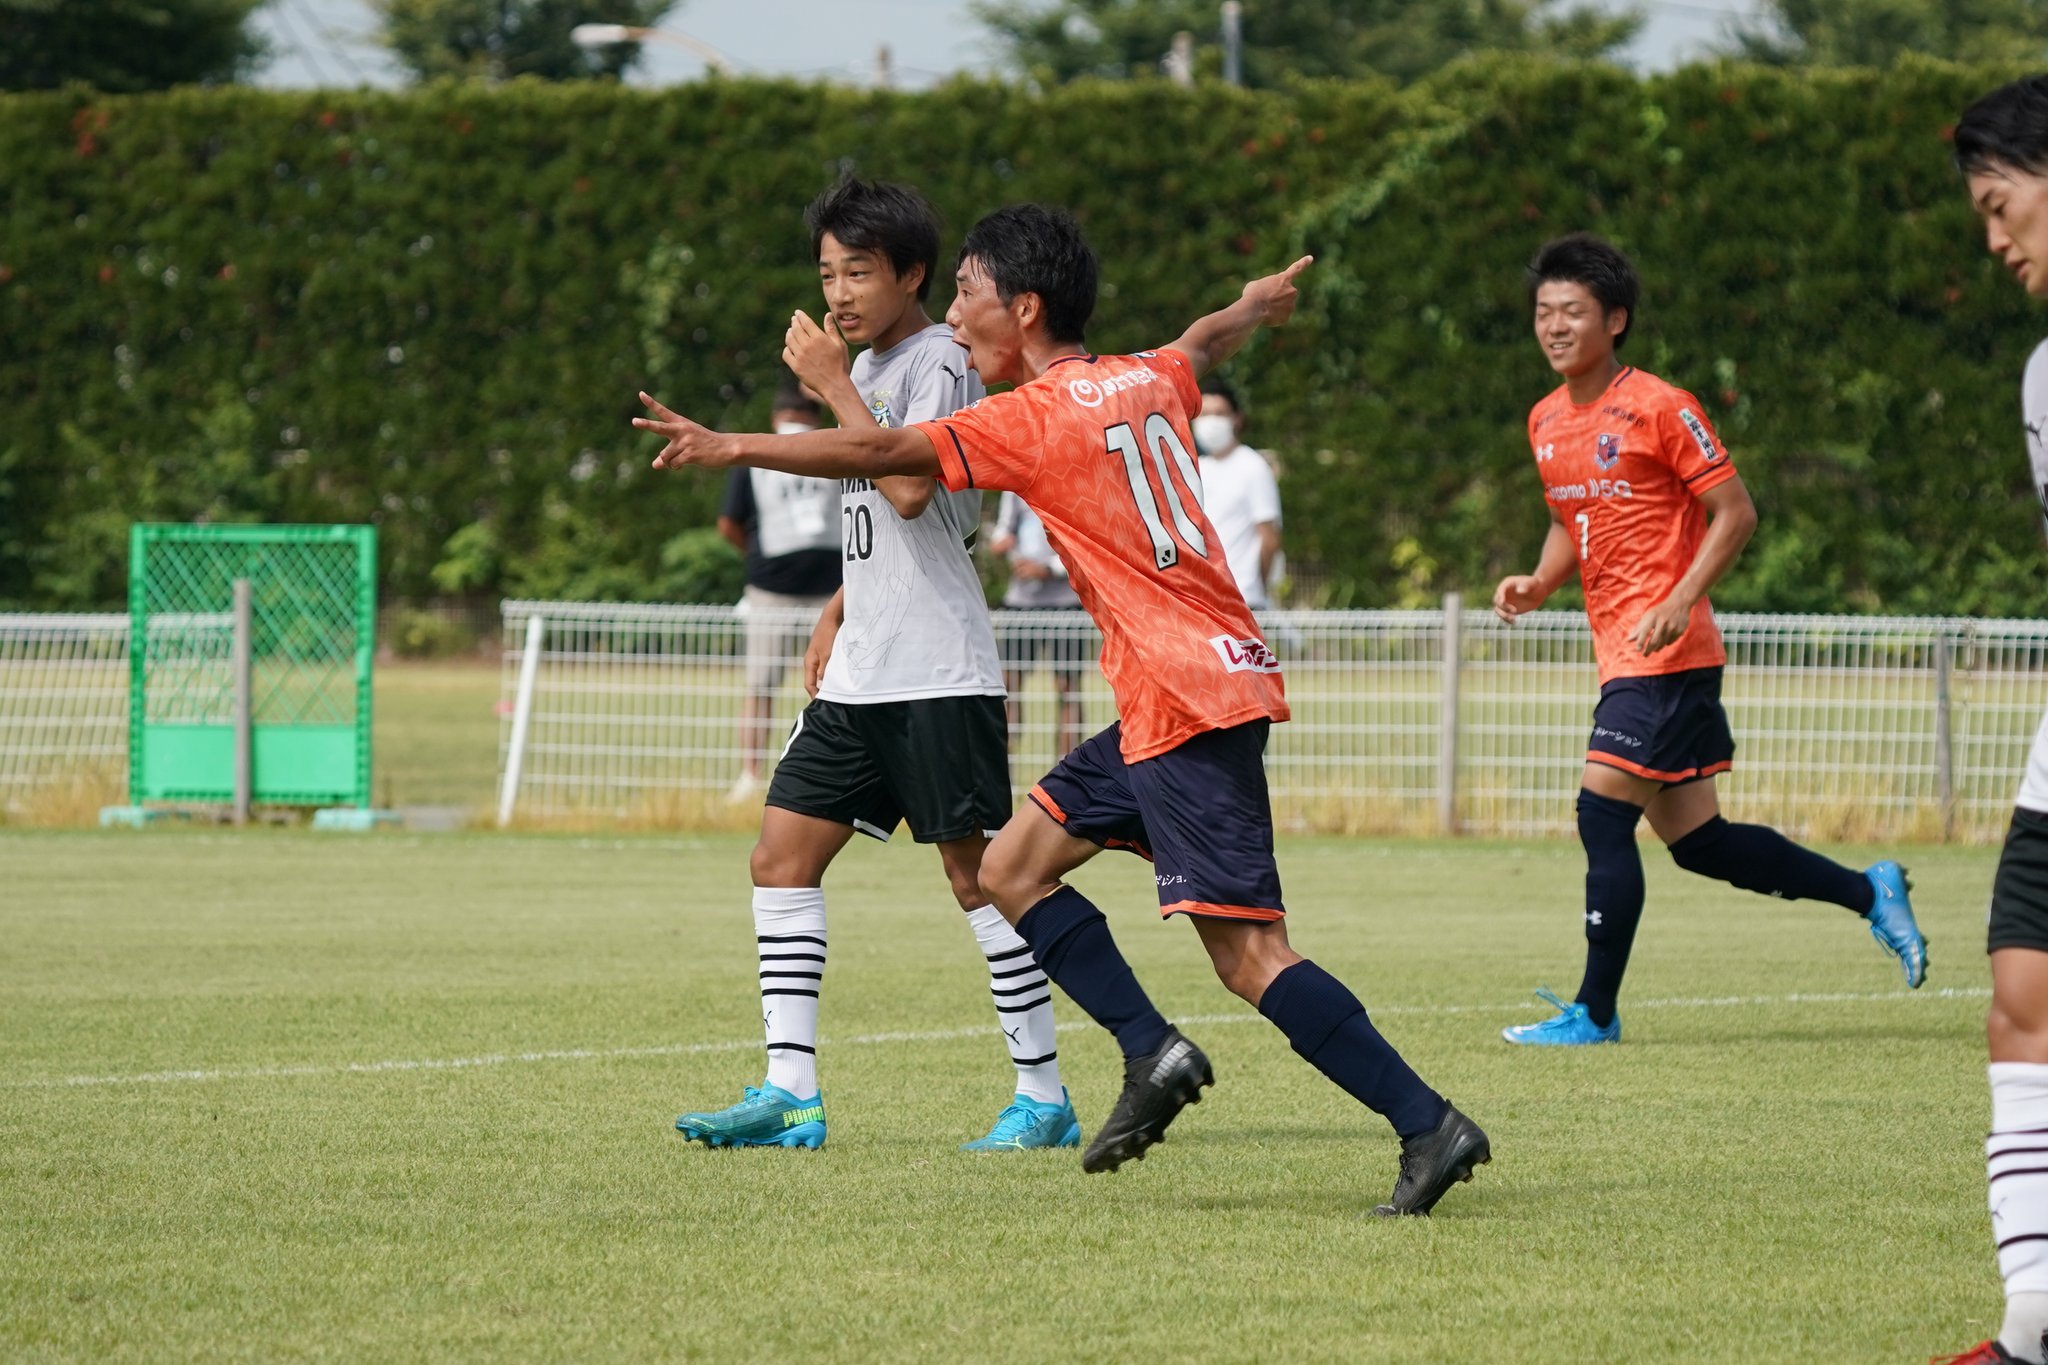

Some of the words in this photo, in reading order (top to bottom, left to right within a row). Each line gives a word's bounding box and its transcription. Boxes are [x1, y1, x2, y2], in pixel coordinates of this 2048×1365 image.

[1104, 412, 1208, 571] 10
[843, 503, 874, 562] 20
[1575, 513, 1589, 560] 7
[782, 1105, 825, 1128] PUMA
